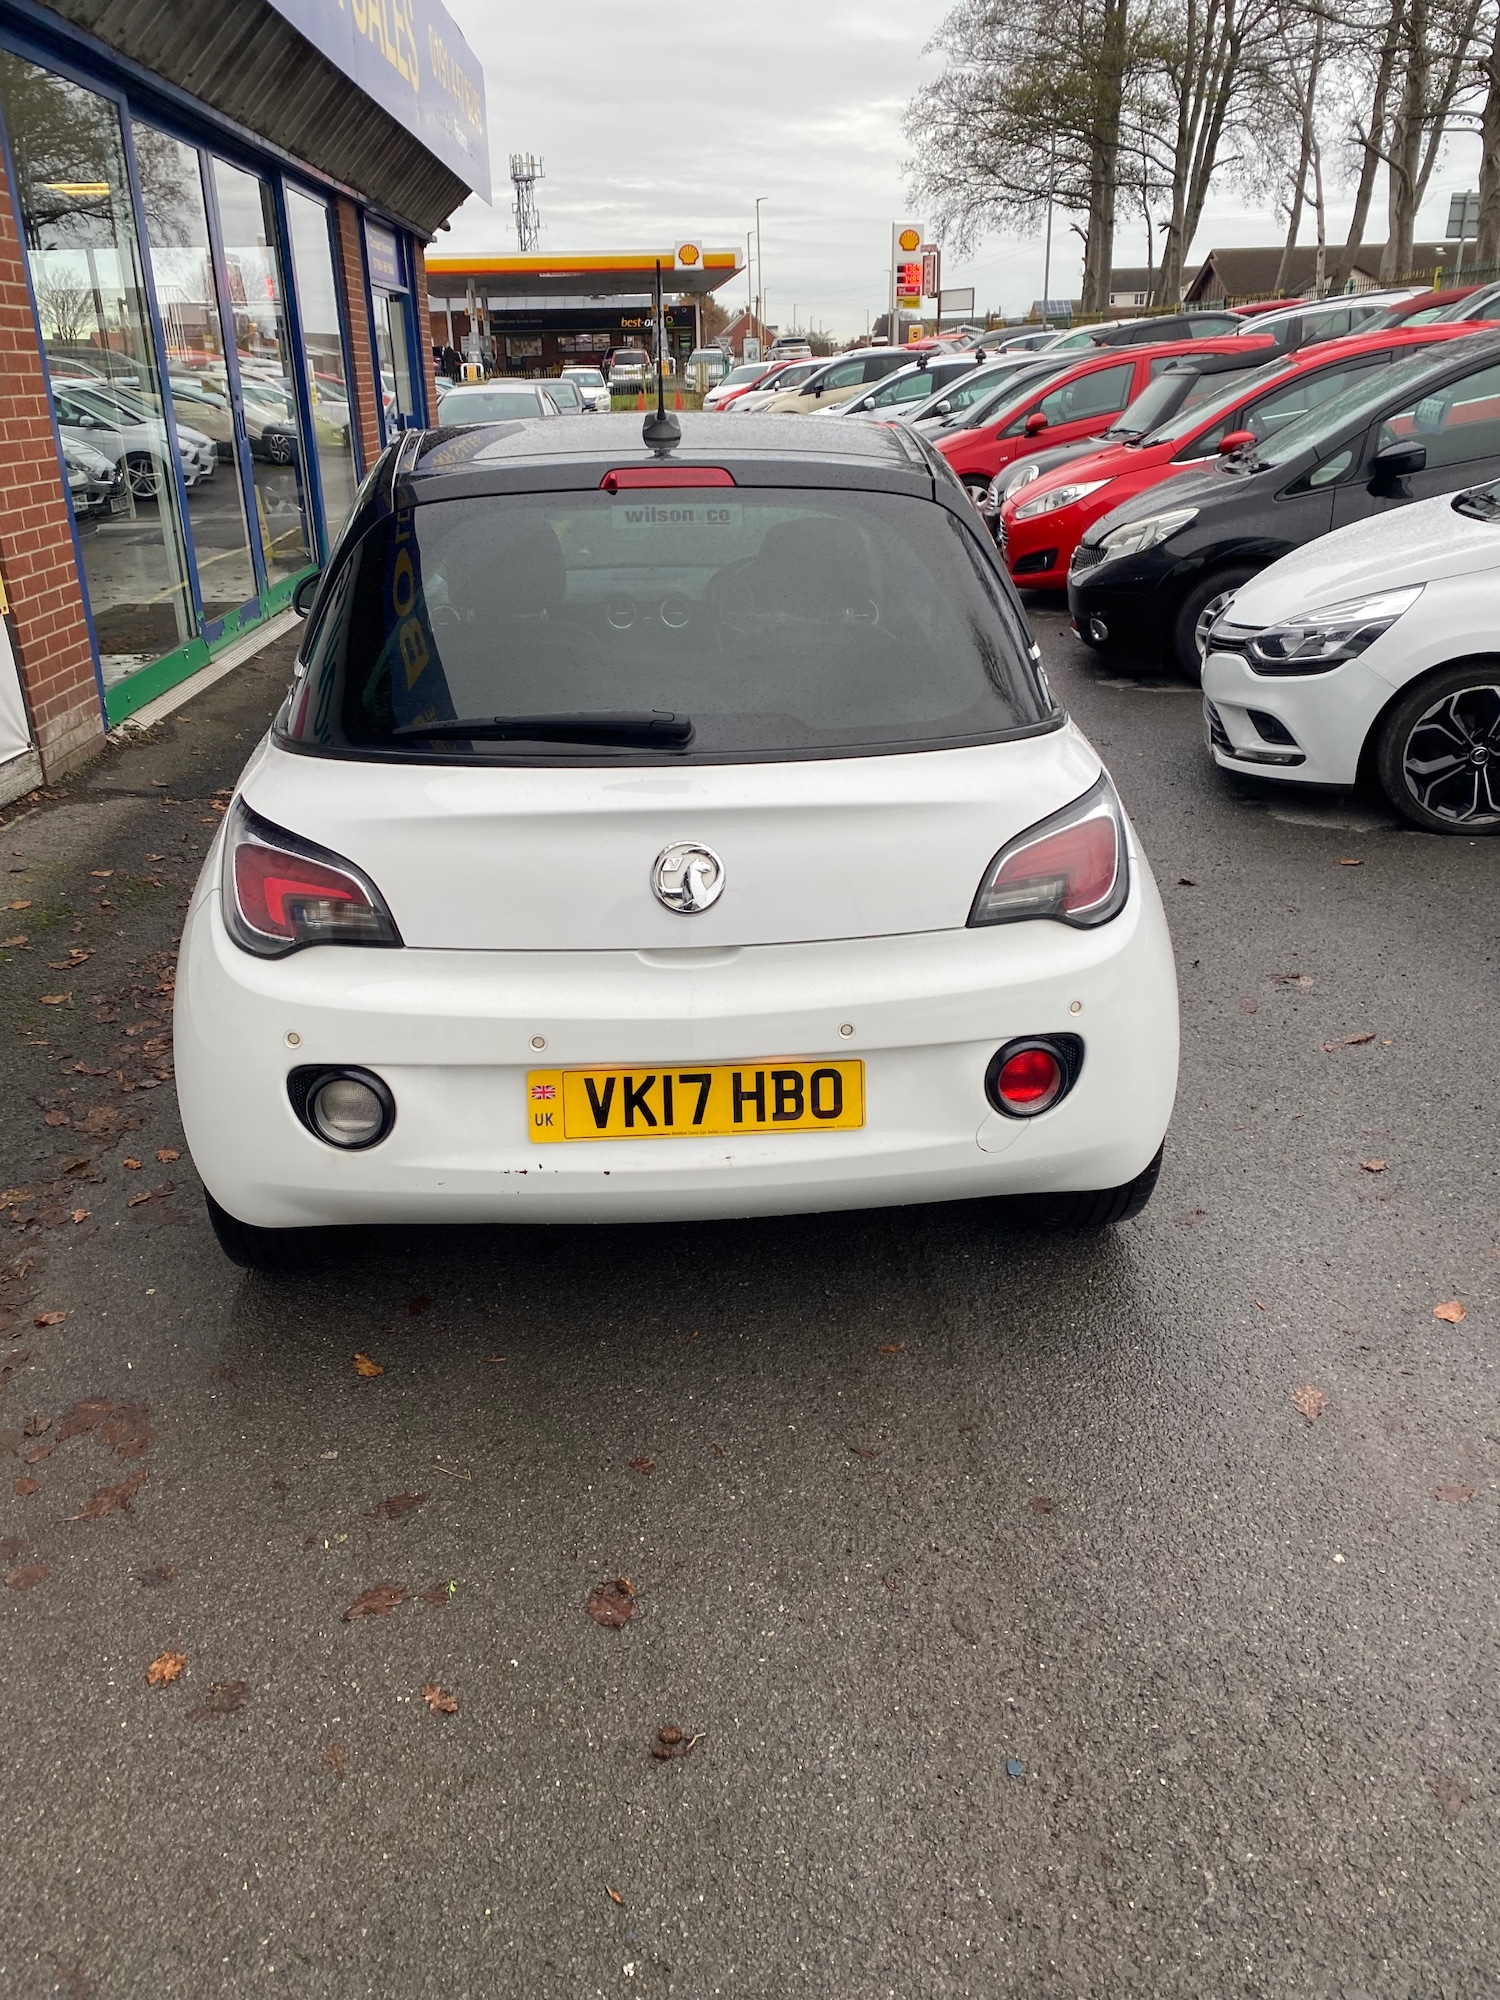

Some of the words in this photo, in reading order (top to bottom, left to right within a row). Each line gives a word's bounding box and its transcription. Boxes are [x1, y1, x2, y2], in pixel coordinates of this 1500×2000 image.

[352, 0, 420, 93] LES
[624, 506, 695, 523] wilson
[706, 508, 730, 522] co
[584, 1074, 712, 1129] VK17
[732, 1068, 843, 1123] HBO
[534, 1112, 554, 1127] UK
